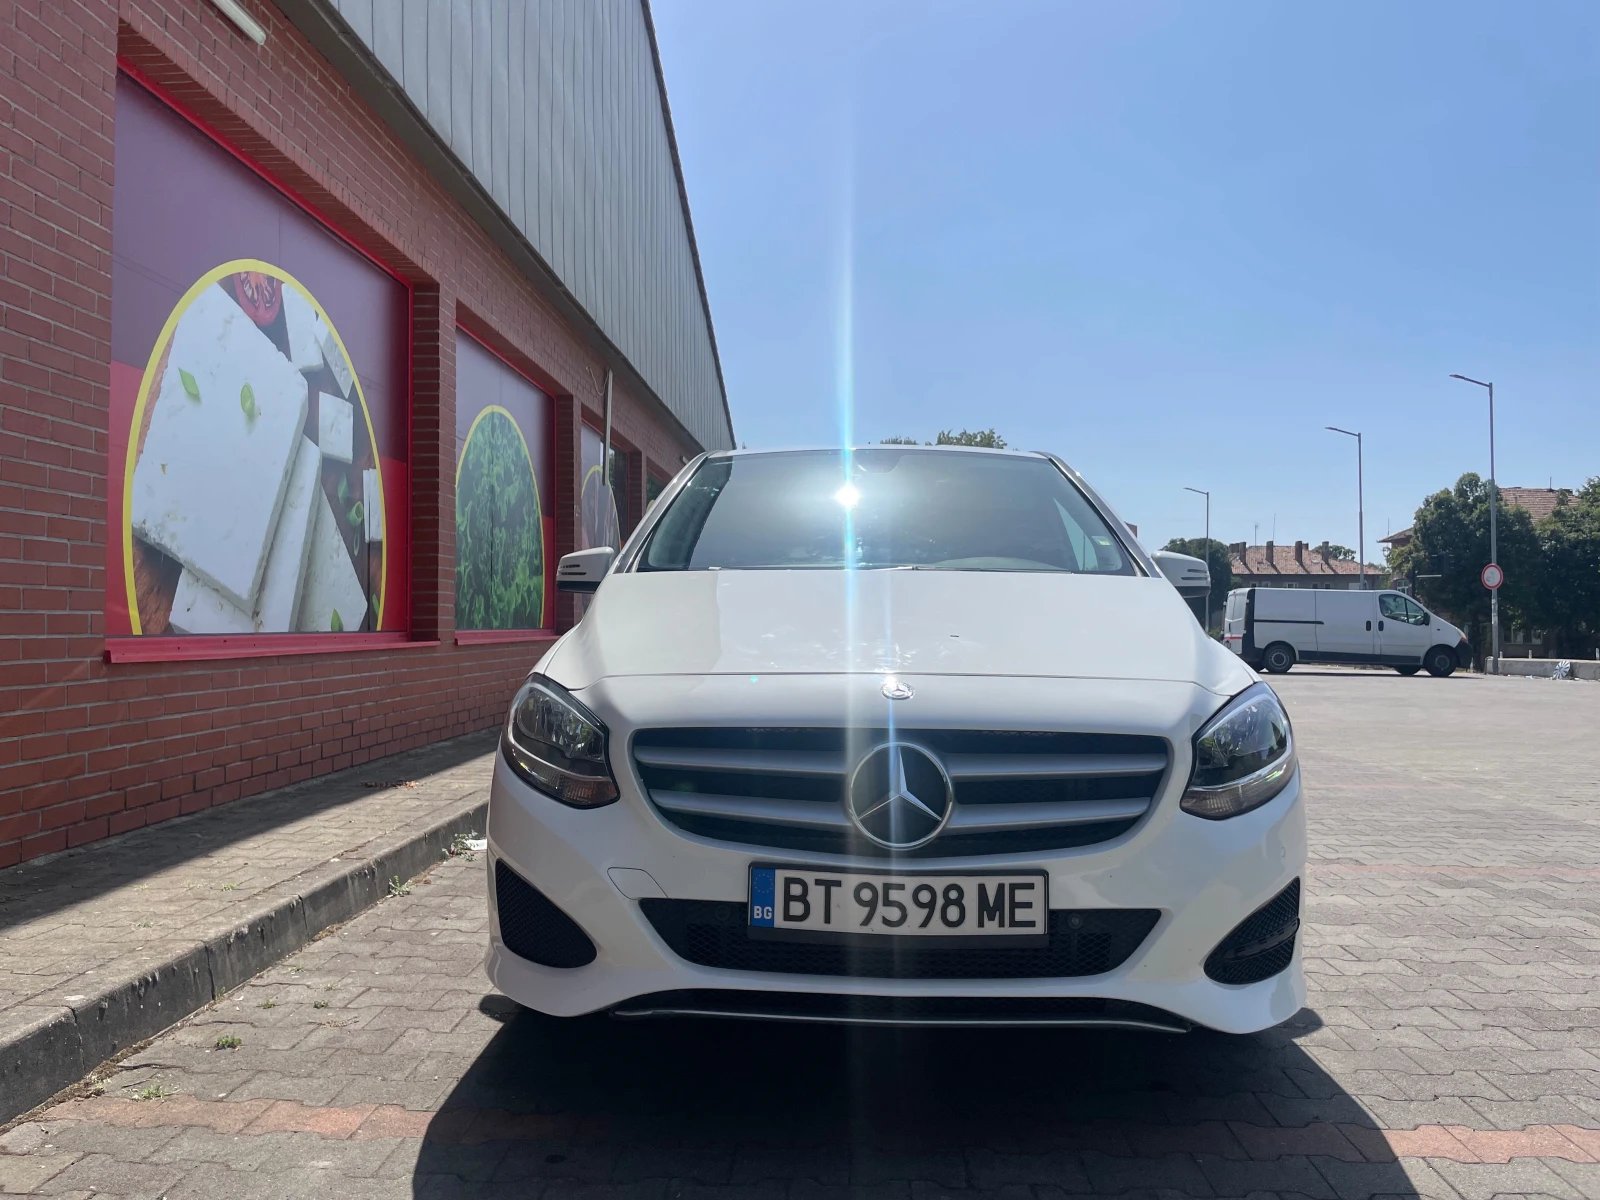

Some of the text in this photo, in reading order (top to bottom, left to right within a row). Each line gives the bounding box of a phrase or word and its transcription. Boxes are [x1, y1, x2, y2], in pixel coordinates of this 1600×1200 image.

[753, 905, 773, 920] BG
[783, 877, 1036, 928] BT 9598 ME
